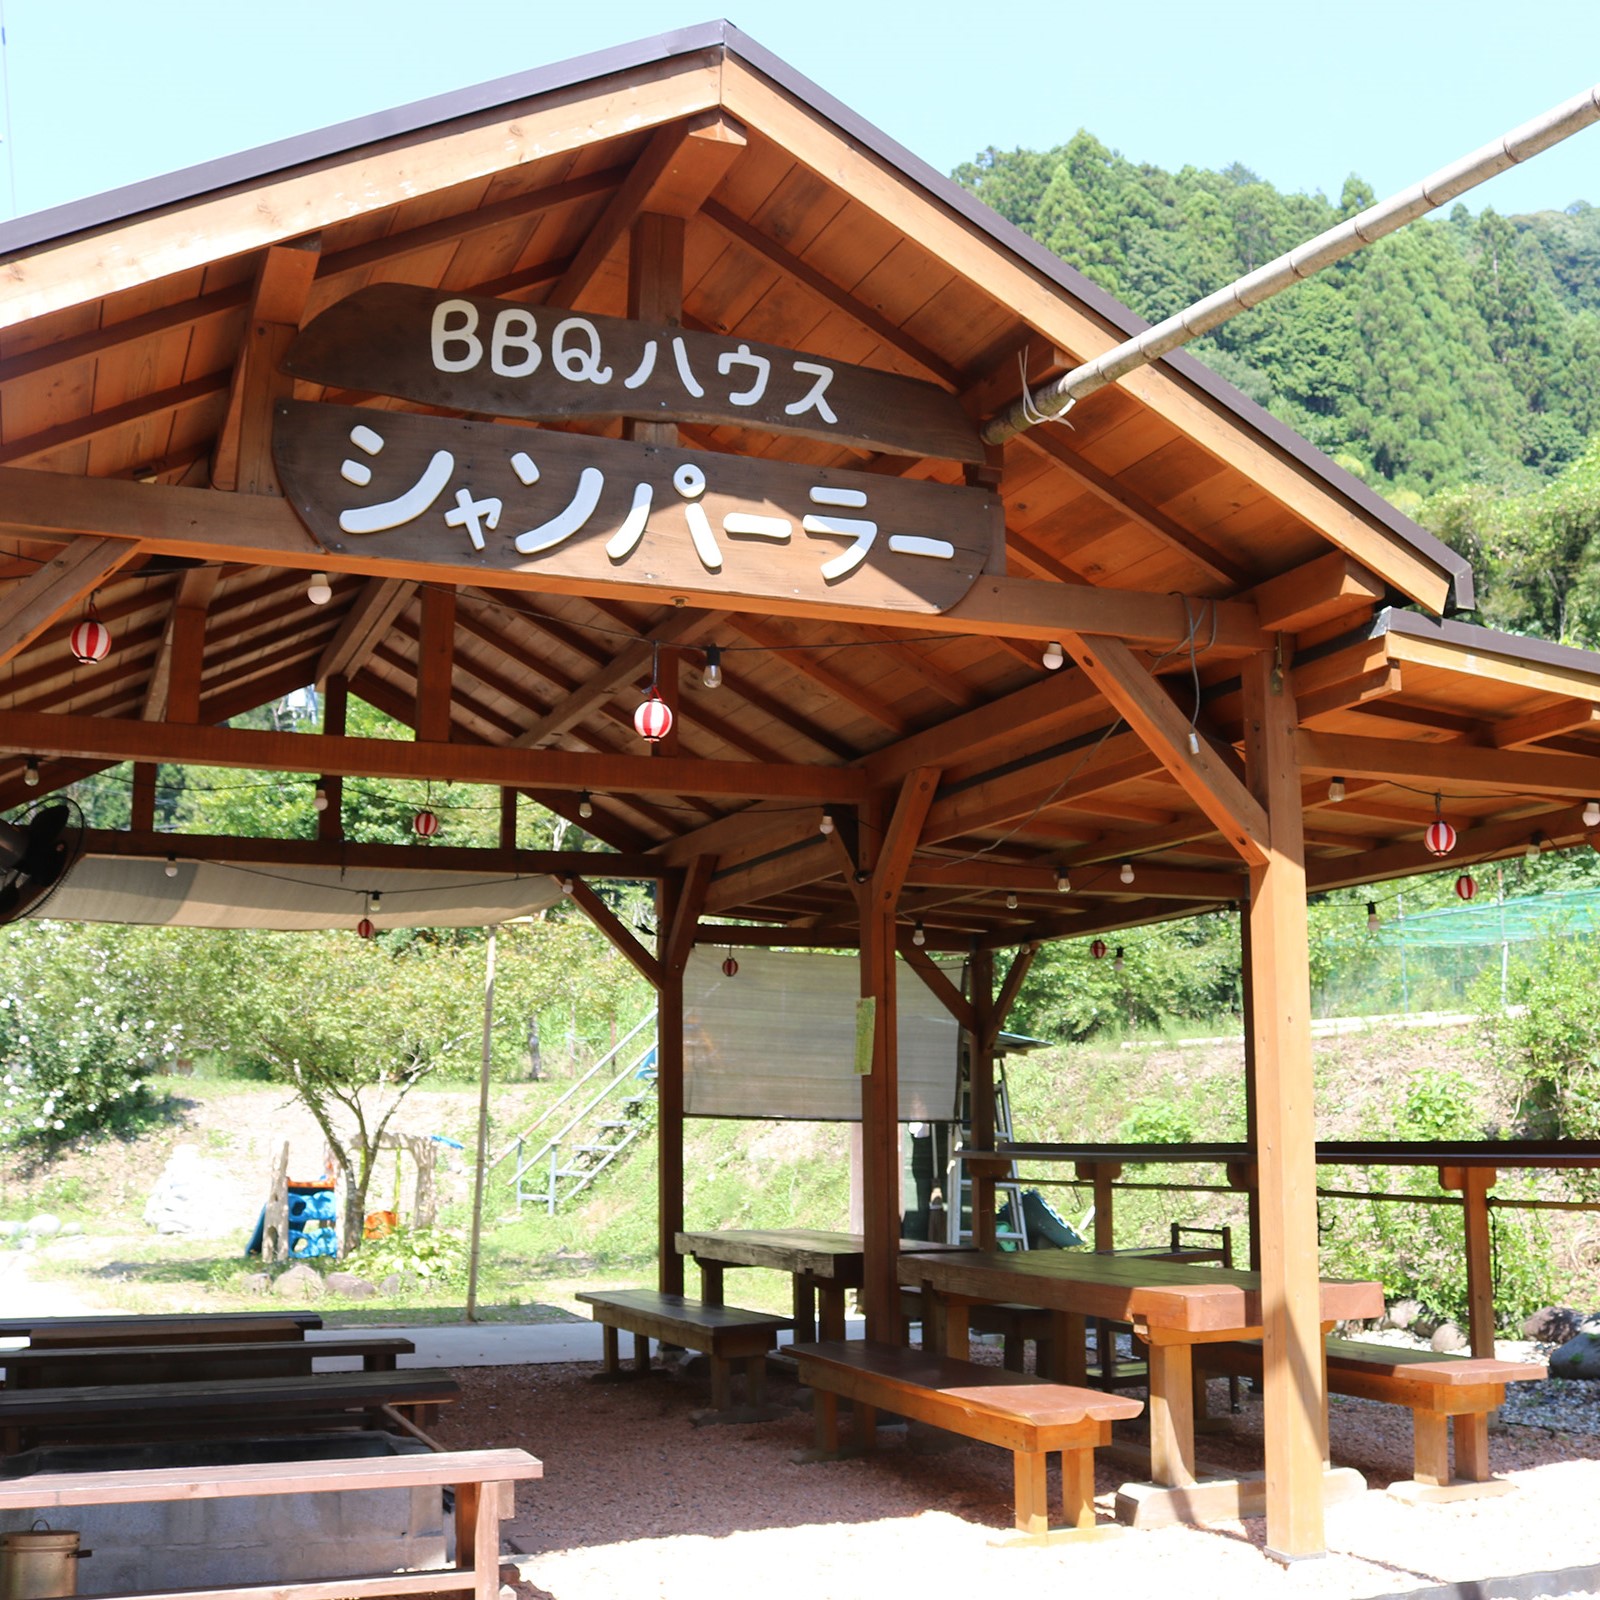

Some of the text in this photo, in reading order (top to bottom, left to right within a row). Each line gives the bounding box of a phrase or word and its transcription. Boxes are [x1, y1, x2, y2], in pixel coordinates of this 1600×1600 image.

[430, 299, 839, 425] BBQハウス
[339, 424, 955, 581] シャンパーラー
